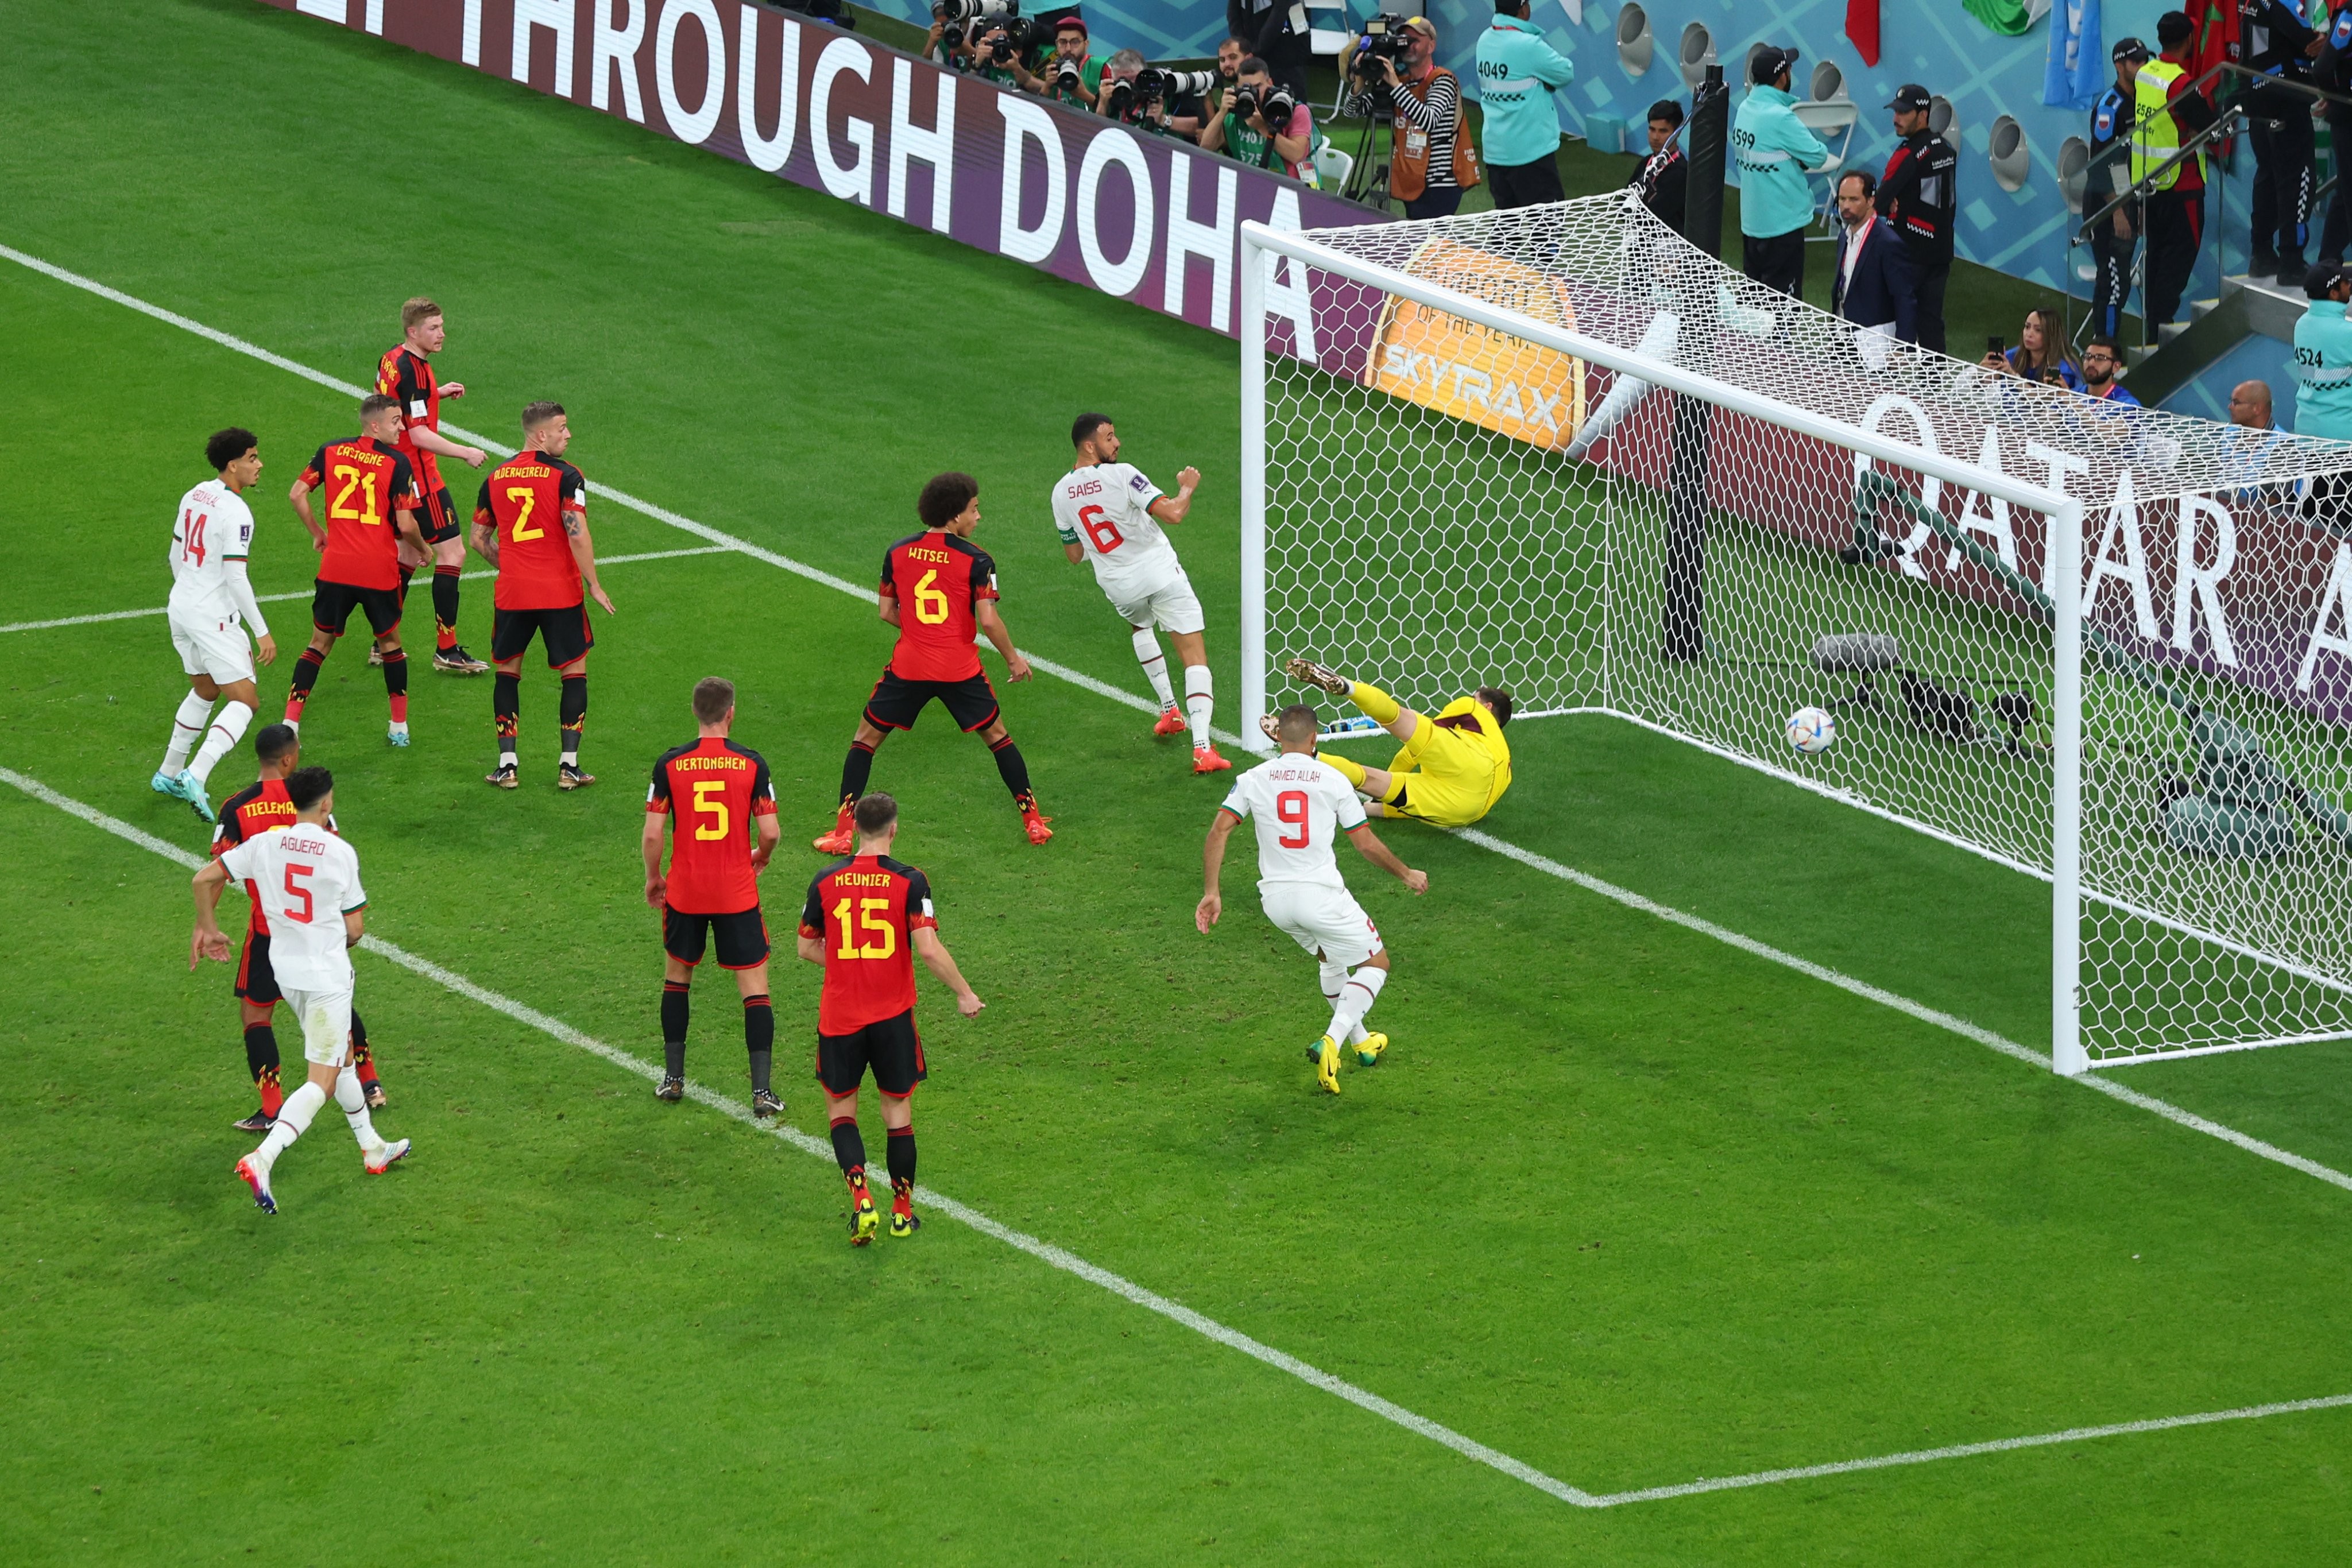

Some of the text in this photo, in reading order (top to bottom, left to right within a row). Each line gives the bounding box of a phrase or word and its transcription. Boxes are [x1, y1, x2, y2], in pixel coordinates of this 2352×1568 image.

[1478, 60, 1508, 80] 4049
[997, 91, 1317, 364] DOHA
[1382, 344, 1563, 434] SKYTRAX
[336, 445, 385, 466] CASTAGNE
[493, 466, 550, 481] ALDERWEIRELD
[331, 464, 381, 525] 21
[506, 487, 544, 543] 2
[1068, 480, 1102, 499] SAISS
[183, 509, 207, 567] 14
[908, 547, 950, 563] WITSEL
[1078, 505, 1124, 554] 6
[1854, 393, 2240, 670] QATAR
[914, 570, 949, 624] 6
[675, 757, 746, 772] VERTONGHEN
[1268, 769, 1321, 783] HAMED ALLAH
[693, 780, 729, 841] 5
[1276, 790, 1310, 849] 9
[284, 862, 314, 924] 5
[835, 873, 891, 887] MEUNIER
[832, 898, 895, 959] 15
